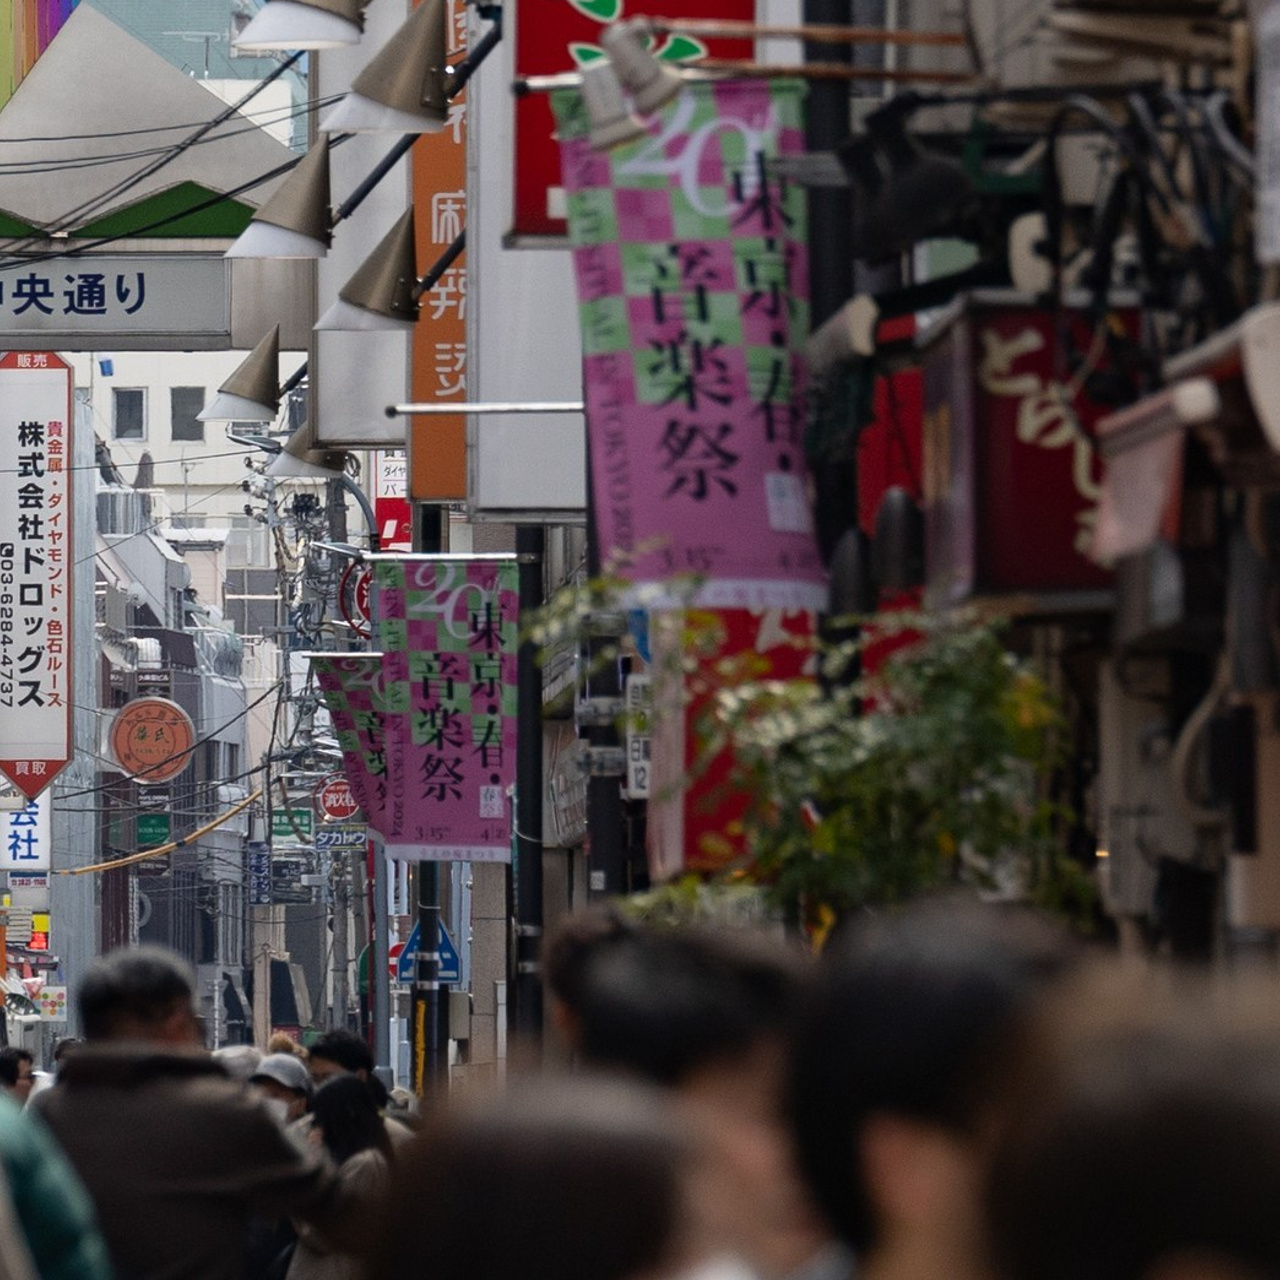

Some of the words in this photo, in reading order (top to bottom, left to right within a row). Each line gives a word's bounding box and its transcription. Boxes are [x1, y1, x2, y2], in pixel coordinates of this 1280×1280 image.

[17, 354, 47, 368] 販売
[17, 421, 46, 708] 株式会社ドロッグス
[47, 421, 63, 708] 貴金属・ダイヤモンド・色石ルース
[0, 559, 14, 708] 03-6284-4737
[421, 653, 465, 803] 音楽祭
[16, 761, 46, 776] 買取
[392, 742, 405, 798] TOKYO
[316, 831, 366, 845] タカトウ
[391, 801, 405, 837] 2024
